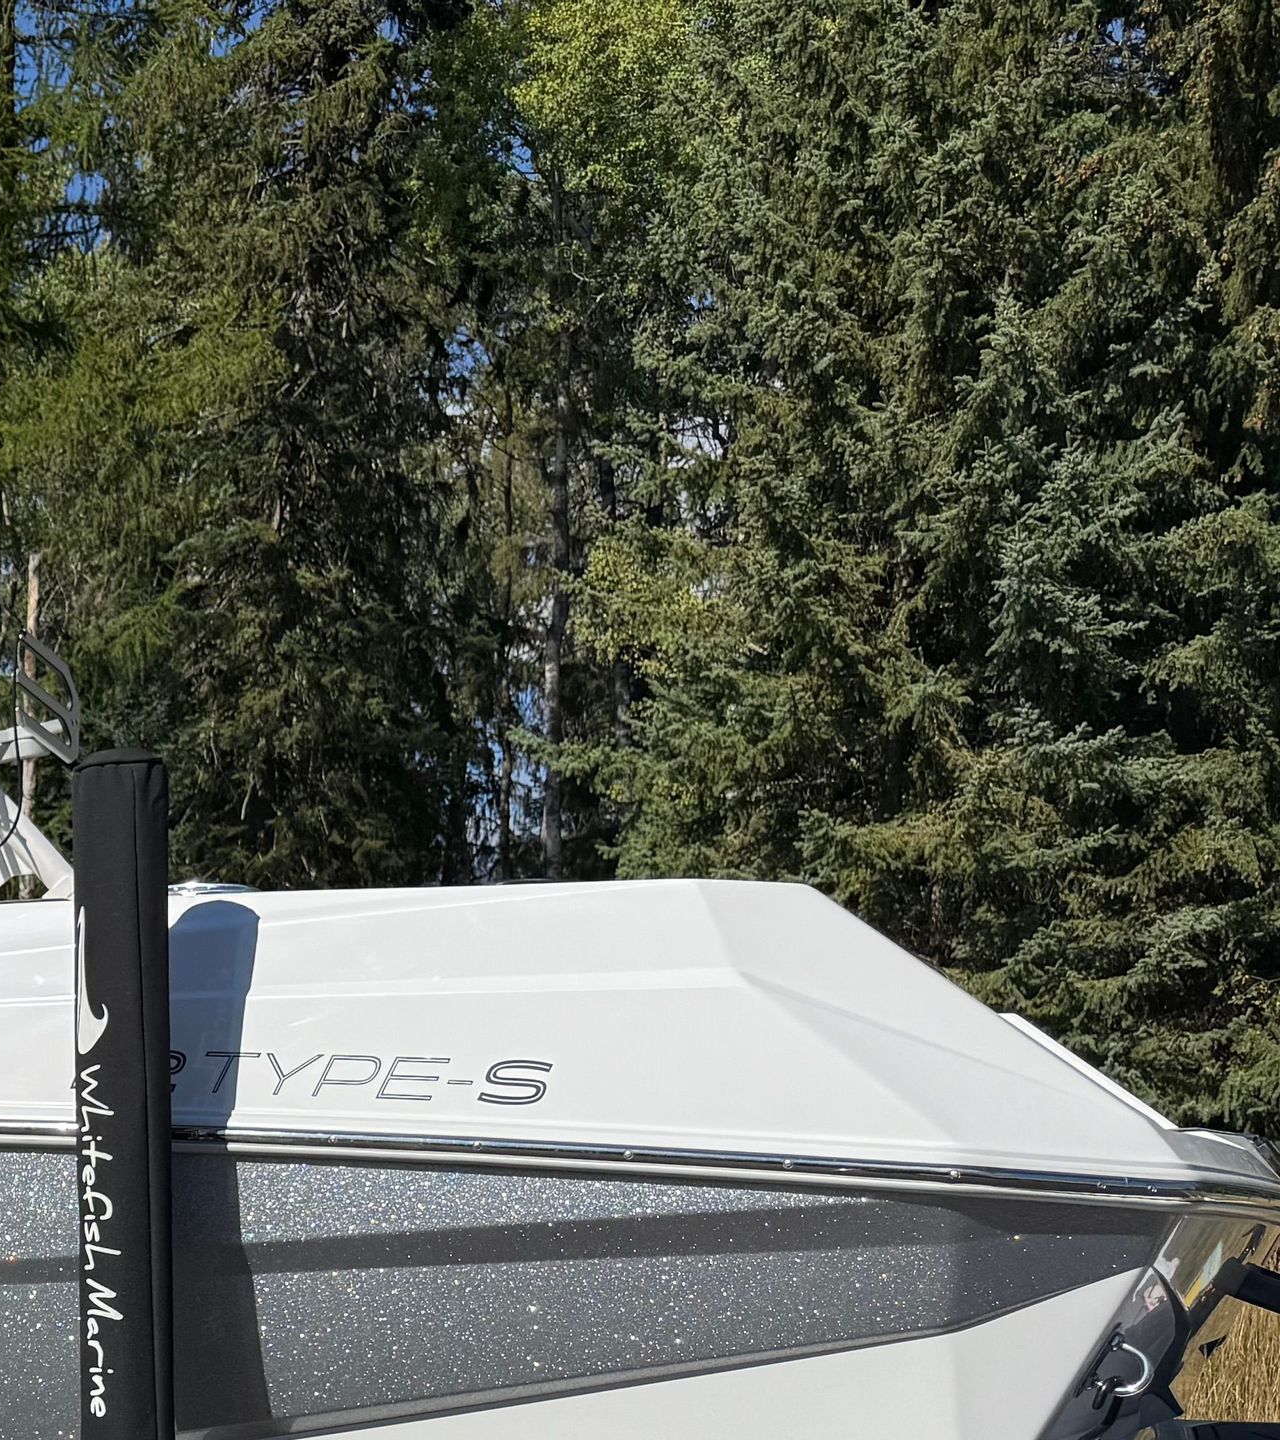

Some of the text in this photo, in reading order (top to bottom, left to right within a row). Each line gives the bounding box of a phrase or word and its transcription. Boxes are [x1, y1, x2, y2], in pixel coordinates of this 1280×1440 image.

[204, 1050, 554, 1106] TYPE-S
[80, 1064, 124, 1418] Whitefish Marine
